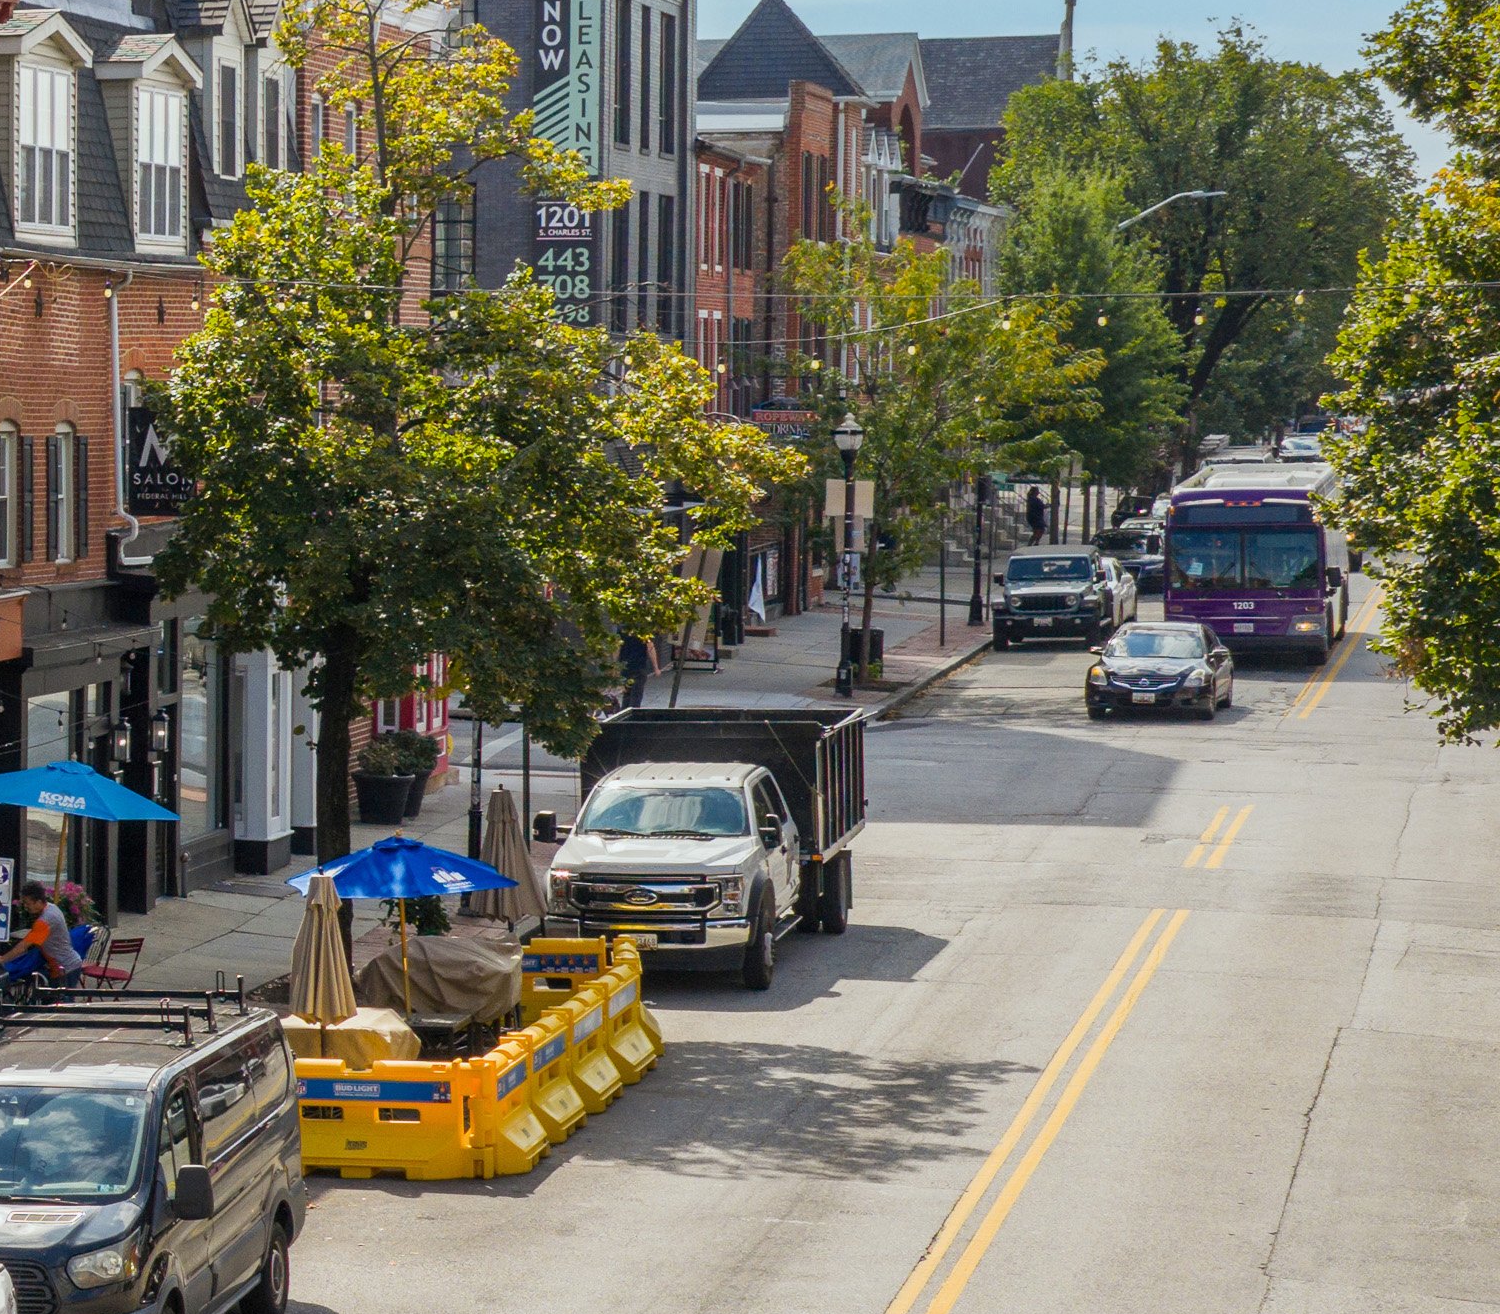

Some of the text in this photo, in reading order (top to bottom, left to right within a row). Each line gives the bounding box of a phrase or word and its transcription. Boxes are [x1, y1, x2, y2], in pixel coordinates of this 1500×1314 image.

[539, 1, 564, 71] NOW
[536, 206, 591, 228] 1201
[538, 247, 590, 272] 443
[137, 492, 169, 500] FEDERAL
[1233, 601, 1254, 610] 1203
[40, 791, 86, 804] KONA
[336, 1084, 379, 1093] BUD LIGHT
